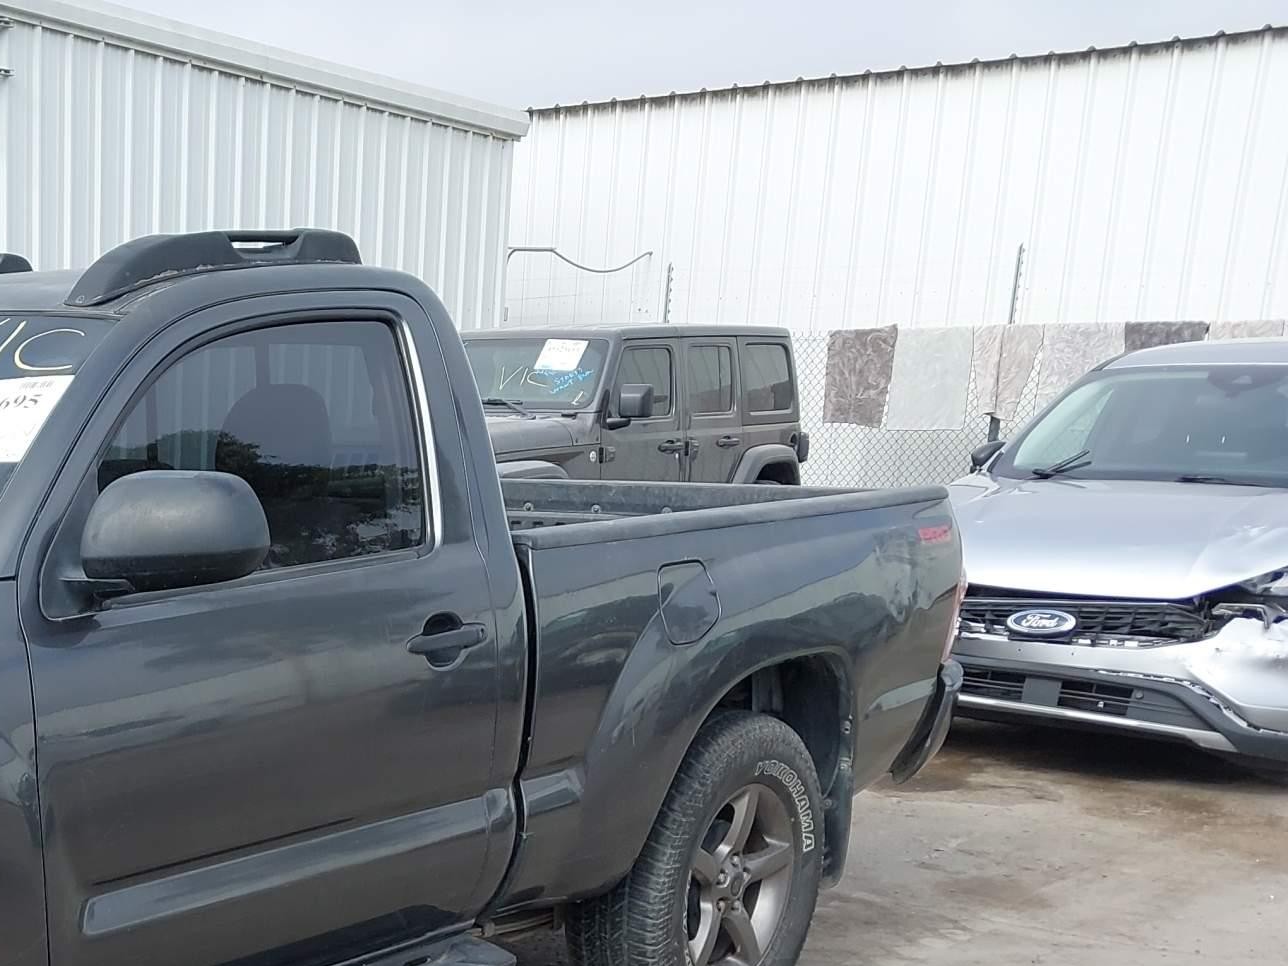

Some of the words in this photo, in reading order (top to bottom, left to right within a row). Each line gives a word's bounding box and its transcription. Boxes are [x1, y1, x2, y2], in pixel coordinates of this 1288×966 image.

[498, 365, 550, 391] VIC
[1021, 613, 1060, 628] Ford
[754, 759, 815, 852] YOKOHAMA
